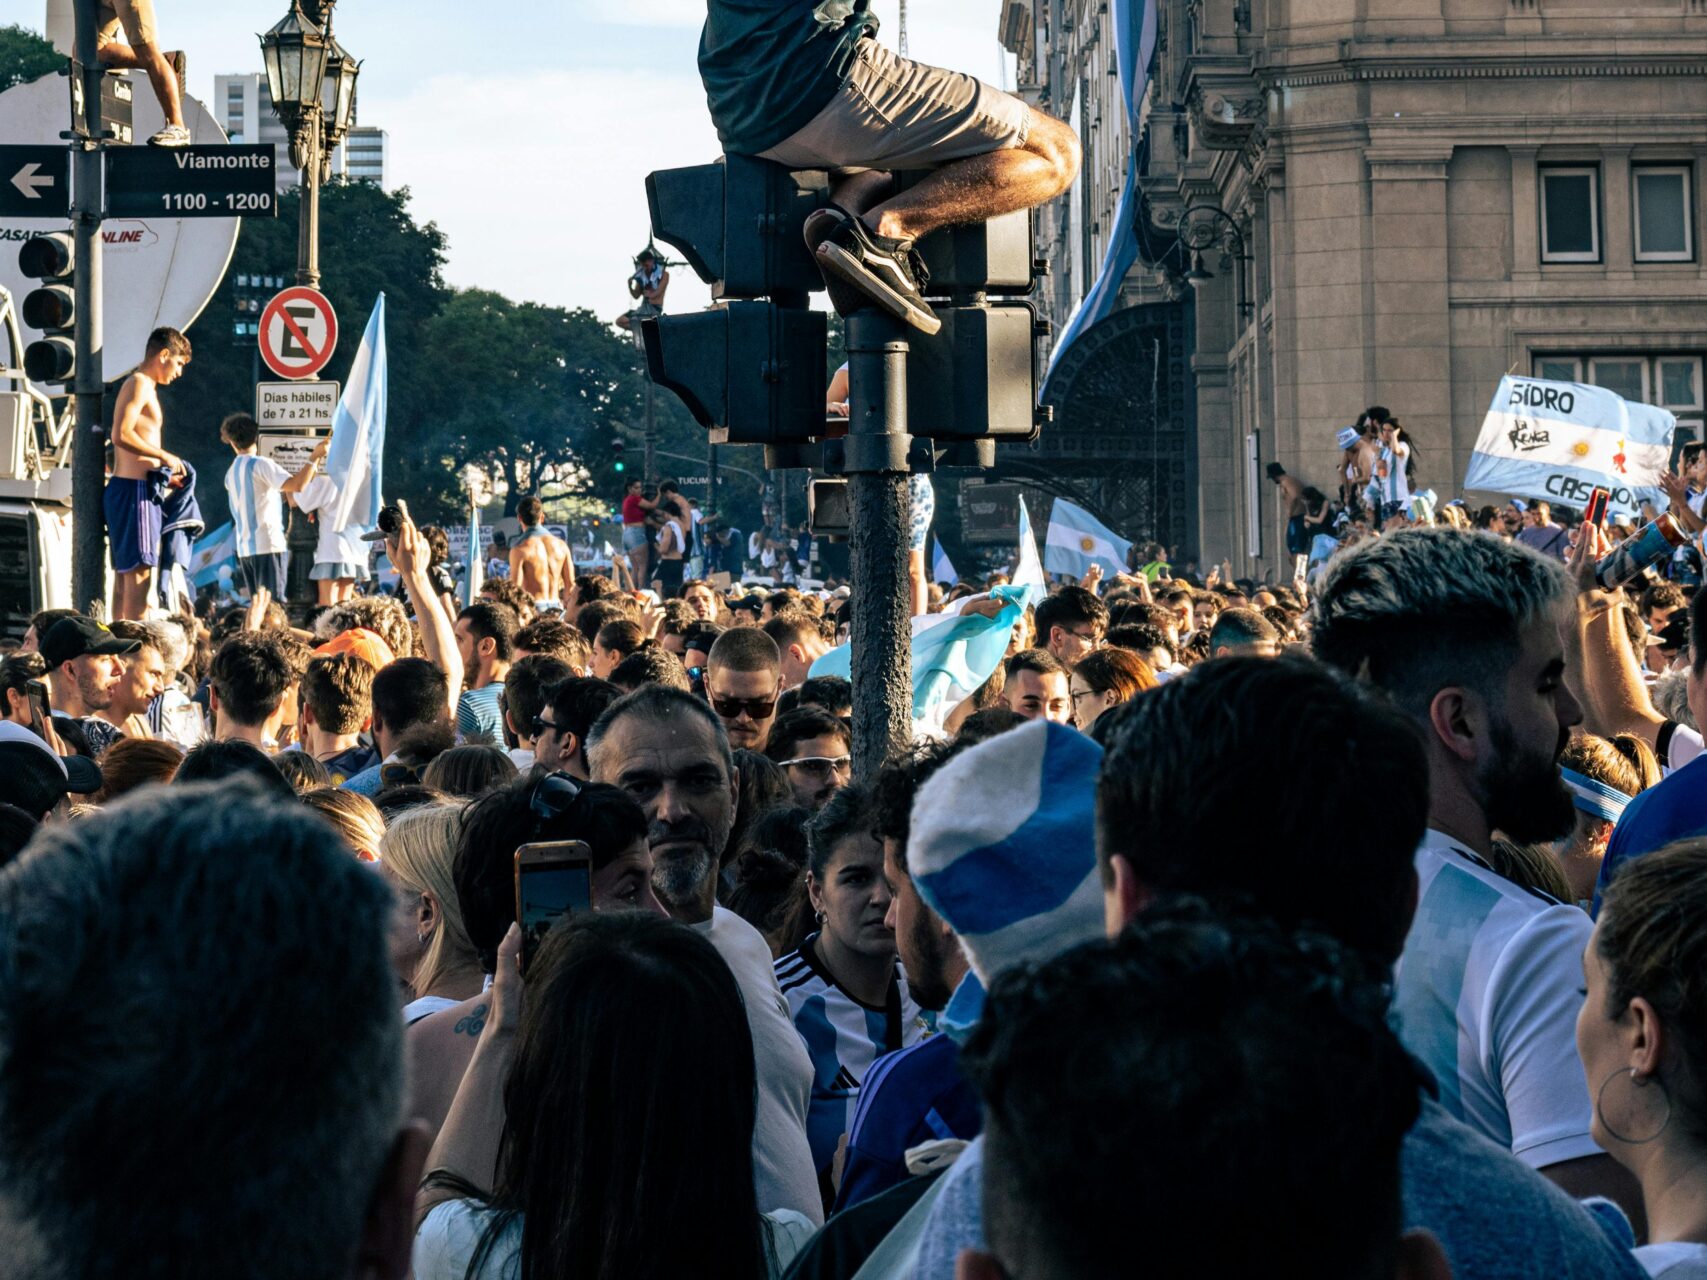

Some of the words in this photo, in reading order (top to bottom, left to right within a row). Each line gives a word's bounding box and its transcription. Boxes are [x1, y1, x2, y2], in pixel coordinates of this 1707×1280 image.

[174, 152, 270, 169] Viamonte
[162, 193, 207, 210] 1100
[226, 193, 271, 210] 1200
[263, 409, 276, 419] de
[279, 409, 286, 418] 7
[289, 410, 296, 418] a
[299, 408, 311, 418] 21
[315, 408, 332, 418] hs.
